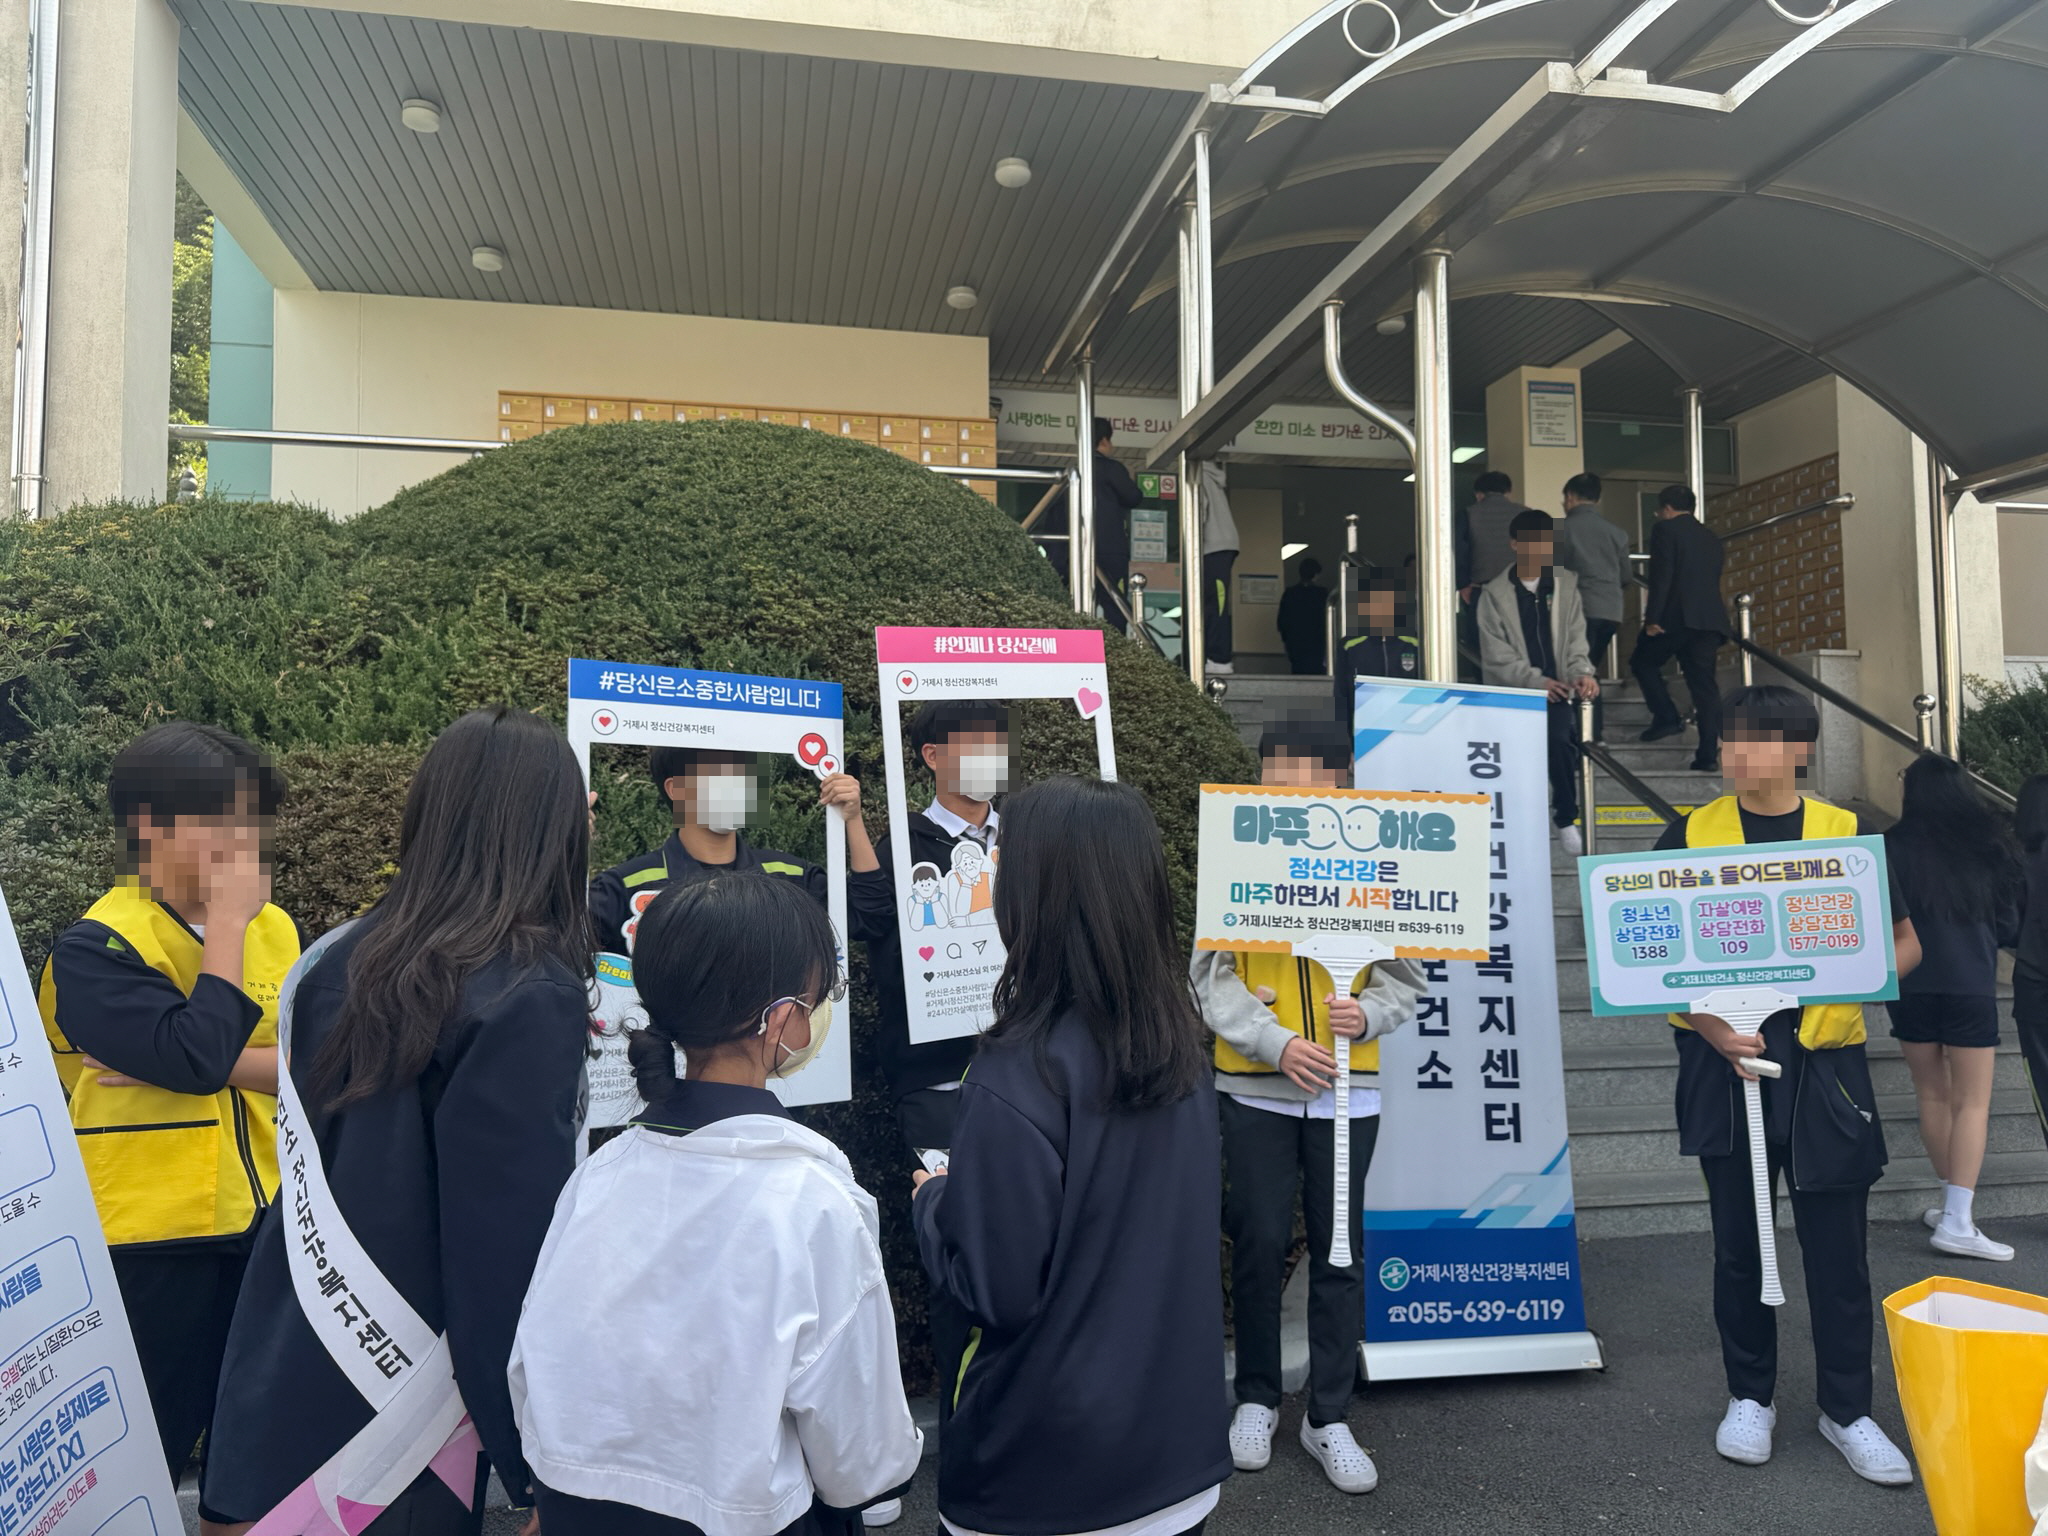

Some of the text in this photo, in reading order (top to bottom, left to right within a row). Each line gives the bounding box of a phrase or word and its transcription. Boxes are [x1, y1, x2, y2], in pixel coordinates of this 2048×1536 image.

[1006, 412, 1062, 428] 사랑하는
[1108, 417, 1140, 433] 다운
[1254, 419, 1284, 436] 환한
[1288, 421, 1316, 437] 미소
[1321, 423, 1364, 439] 반가운
[933, 636, 1057, 655] #언제나 당신곁에
[598, 671, 822, 710] #당신은소중한사람입니다
[921, 677, 998, 688] 거제시 정신건강복지센터
[622, 718, 716, 735] 거제시 정신건강복지센터
[1232, 804, 1457, 852] 마주 해요
[1288, 857, 1400, 883] 정신건강은
[1604, 858, 1845, 892] 당신의 마음을 들어드릴께요
[1230, 882, 1459, 913] 마주하면서 시작합니다
[1697, 899, 1764, 918] 자살예방
[1785, 893, 1854, 914] 정신건강
[1238, 913, 1465, 936] 거제시보건소 정신건강복지센터 639-6119
[1621, 904, 1671, 923] 청소년
[1788, 913, 1856, 933] 상담전화
[1615, 923, 1681, 943] 상담전화
[1699, 918, 1766, 938] 상담전화
[1631, 945, 1669, 960] 1388
[1719, 940, 1749, 955] 109
[1788, 933, 1860, 951] 1577-0199
[1680, 968, 1811, 985] 거제시보건소 정신건강복지센터
[27, 1191, 42, 1209] 수
[293, 1152, 414, 1380] 정신건강복지센터
[1411, 1261, 1571, 1283] 거제시정신건강복지센터
[1407, 1298, 1566, 1324] 055-639-6119
[36, 1310, 104, 1362] 뇌질환으로
[5, 1387, 26, 1417] 것은
[24, 1363, 58, 1399] 아니다.
[17, 1419, 57, 1473] 사람은
[55, 1380, 111, 1437] 실제로
[16, 1456, 61, 1517] 않는다.
[66, 1467, 98, 1507] 의도를
